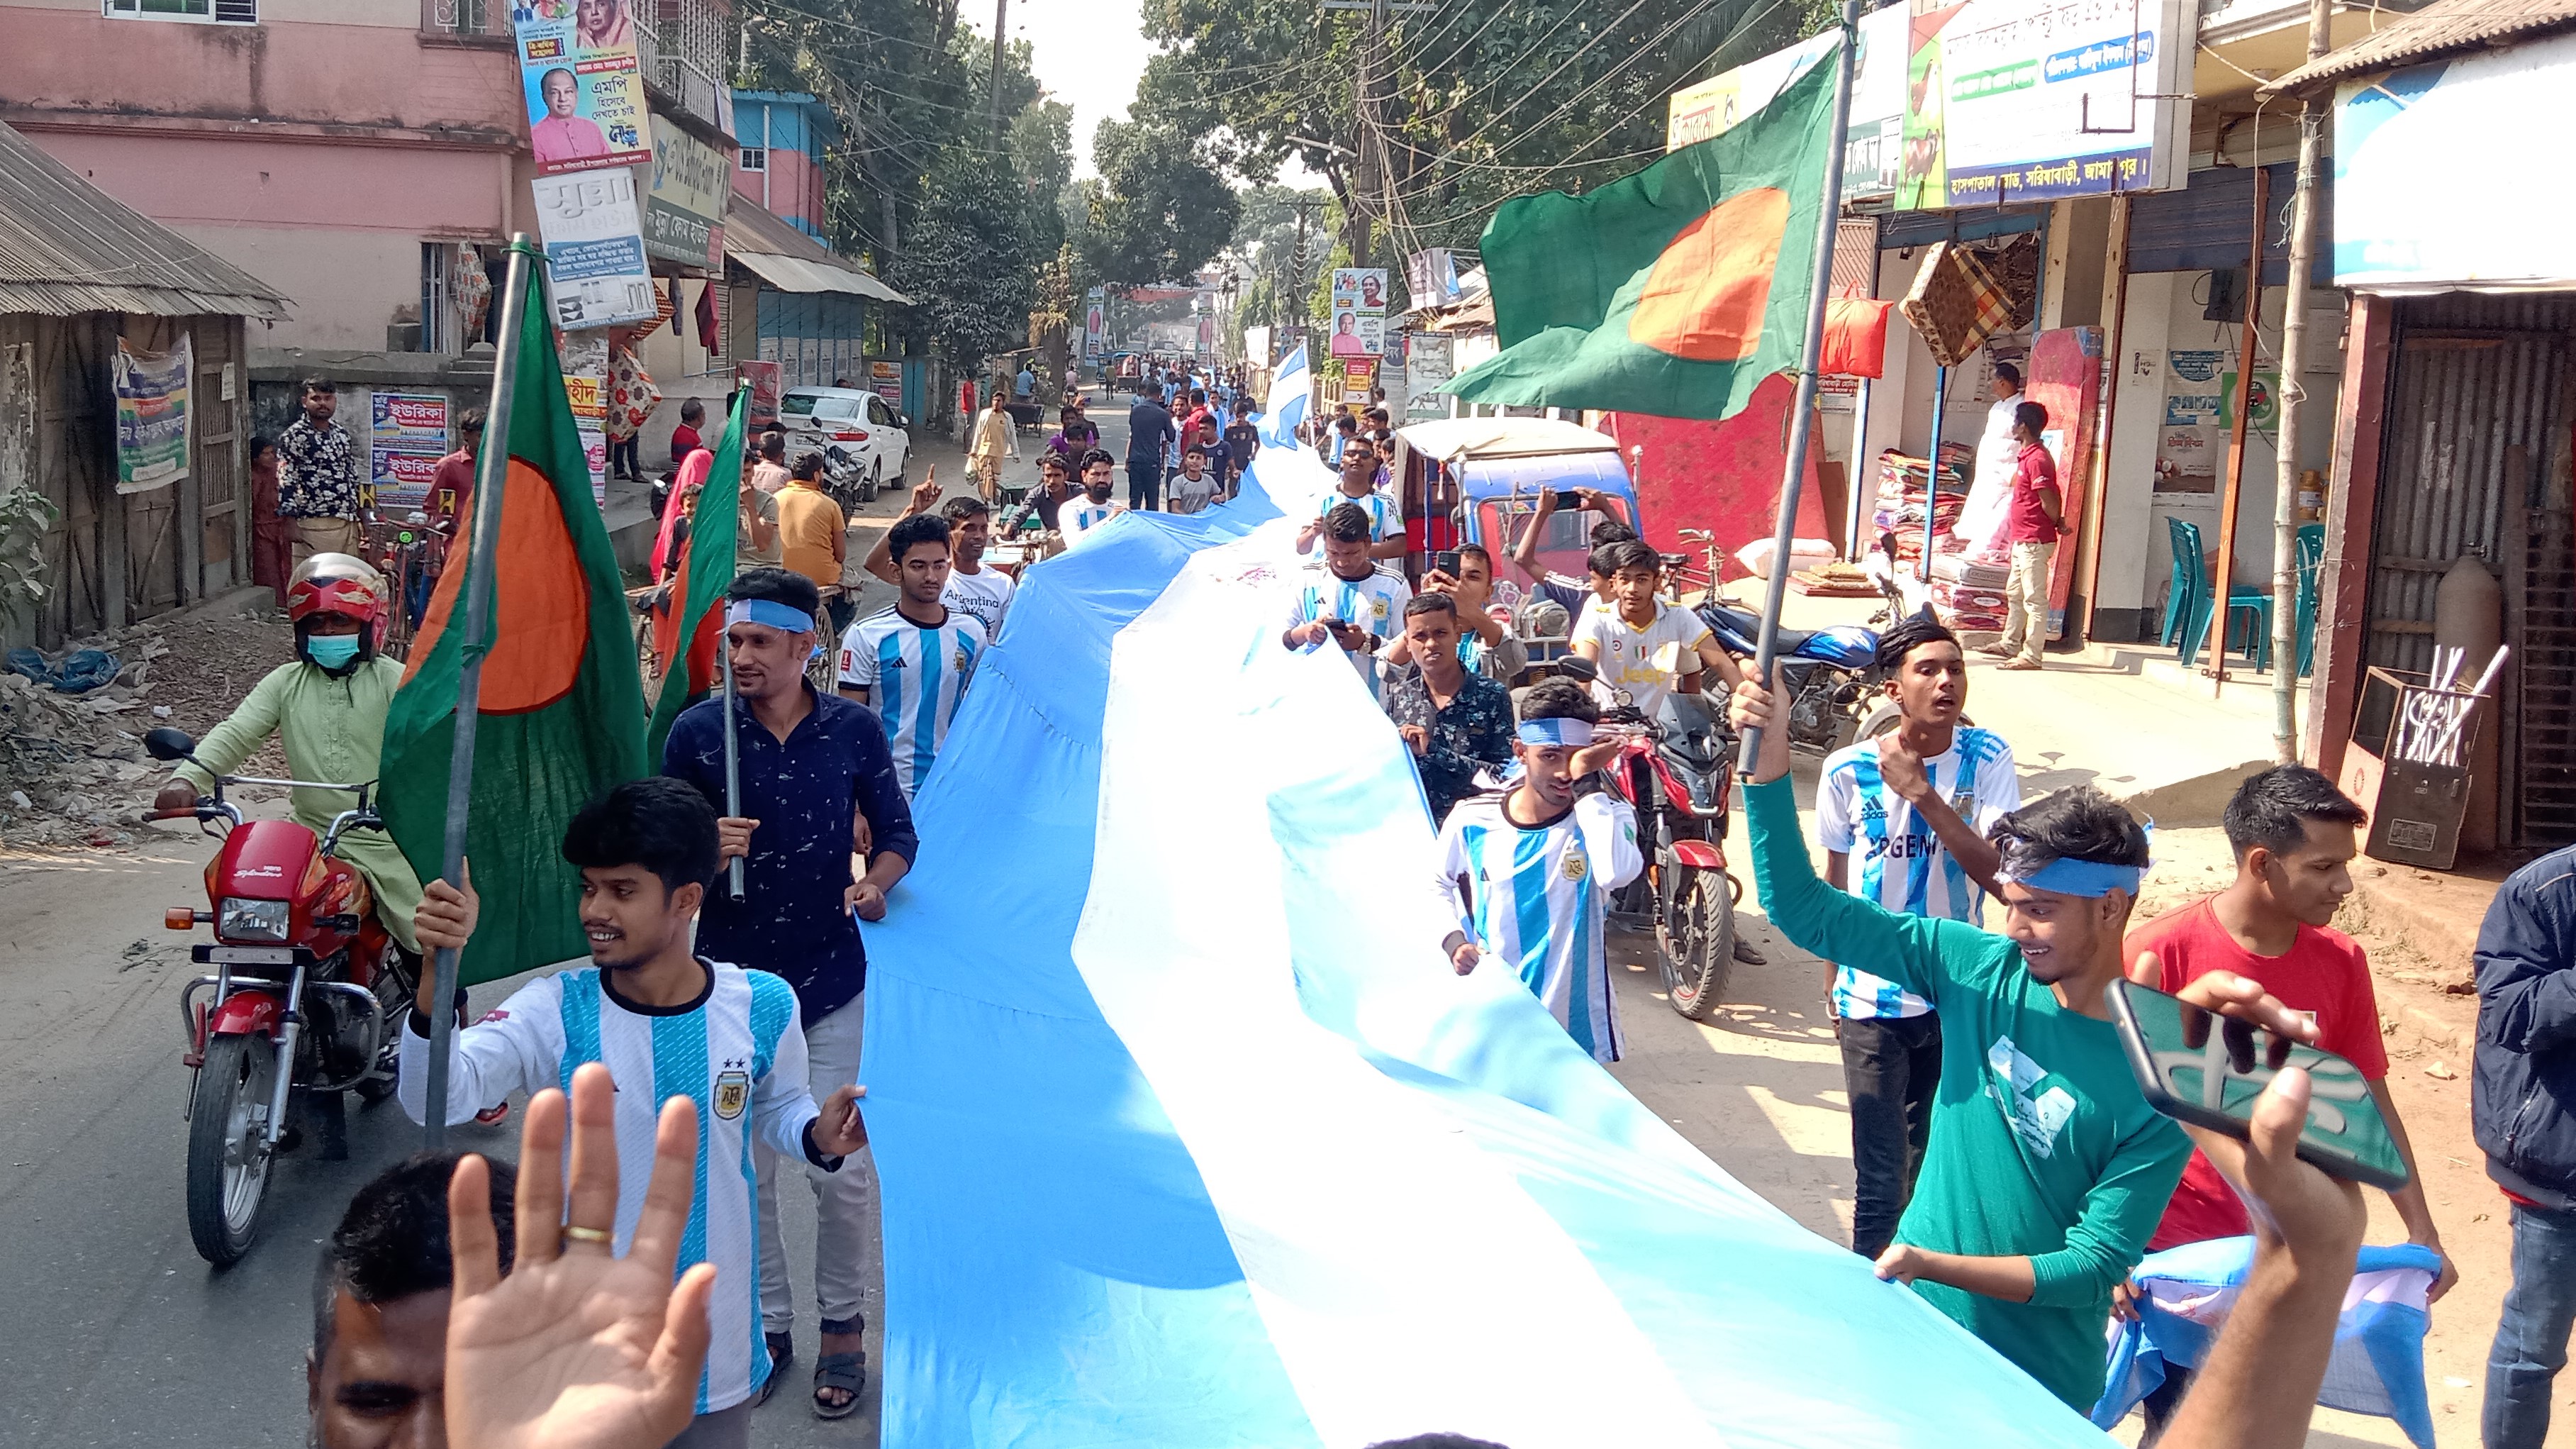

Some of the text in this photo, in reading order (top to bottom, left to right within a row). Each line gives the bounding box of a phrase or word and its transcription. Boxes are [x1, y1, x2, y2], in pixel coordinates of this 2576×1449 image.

[591, 75, 628, 95] এমপি
[597, 97, 625, 108] হিসেবে
[592, 106, 636, 120] দেখতে চাই
[1951, 175, 1996, 196] হাসপাতাল
[2026, 160, 2080, 187] সরিষাবাড়ী,
[2085, 157, 2137, 182] জামাপুর
[390, 403, 445, 419] ইউরিকা
[945, 589, 999, 608] Argentina
[1615, 665, 1668, 686] Jeep
